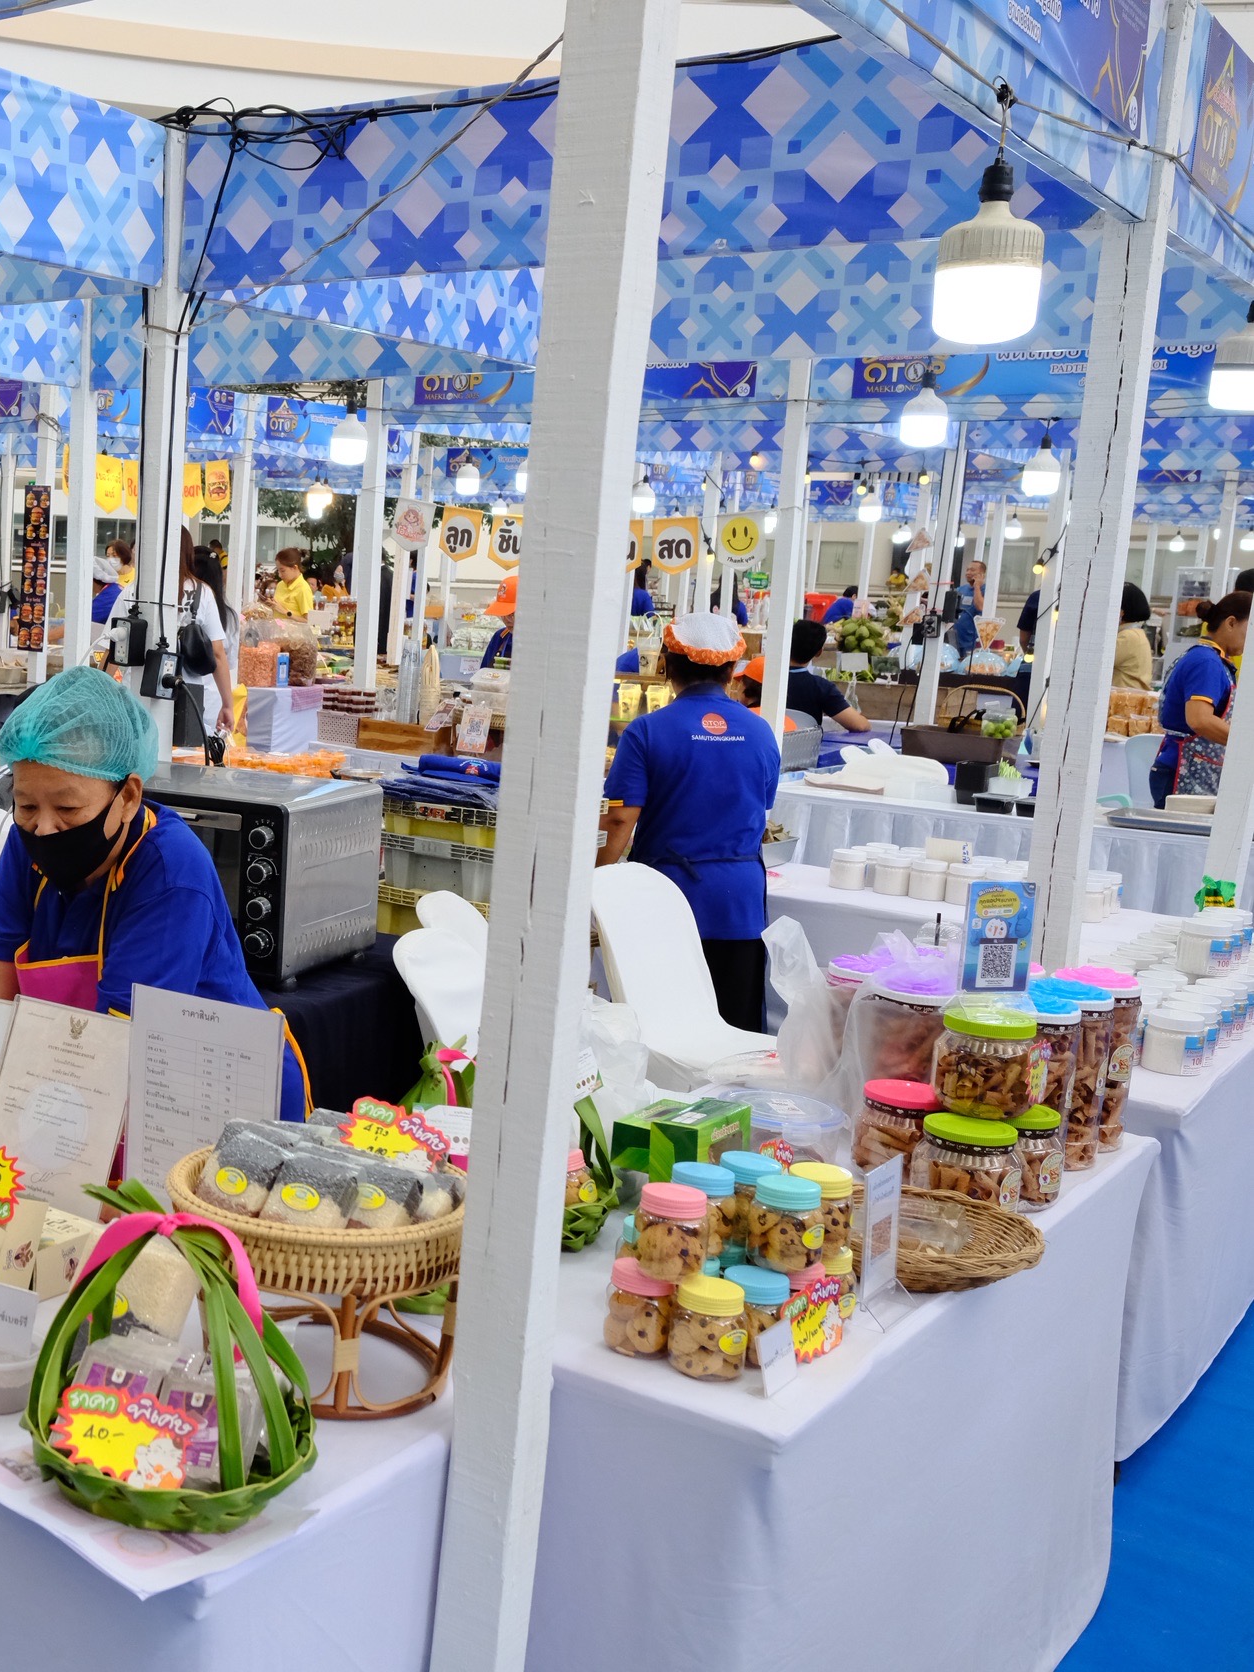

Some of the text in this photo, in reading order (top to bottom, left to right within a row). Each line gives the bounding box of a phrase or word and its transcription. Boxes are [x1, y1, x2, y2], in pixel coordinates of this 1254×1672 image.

[1050, 359, 1167, 375] PADTH OI
[422, 373, 483, 392] OTOP
[865, 383, 919, 394] MAEKLONG
[270, 417, 298, 433] OTOP
[183, 484, 202, 498] ear
[445, 526, 473, 553] ลูก
[658, 536, 692, 561] สด
[1217, 960, 1230, 968] 100
[181, 1008, 220, 1023] ราคาสินค้า
[359, 1102, 446, 1151] ราคา พิเศษ
[69, 1393, 193, 1436] ราคา พิเศษ
